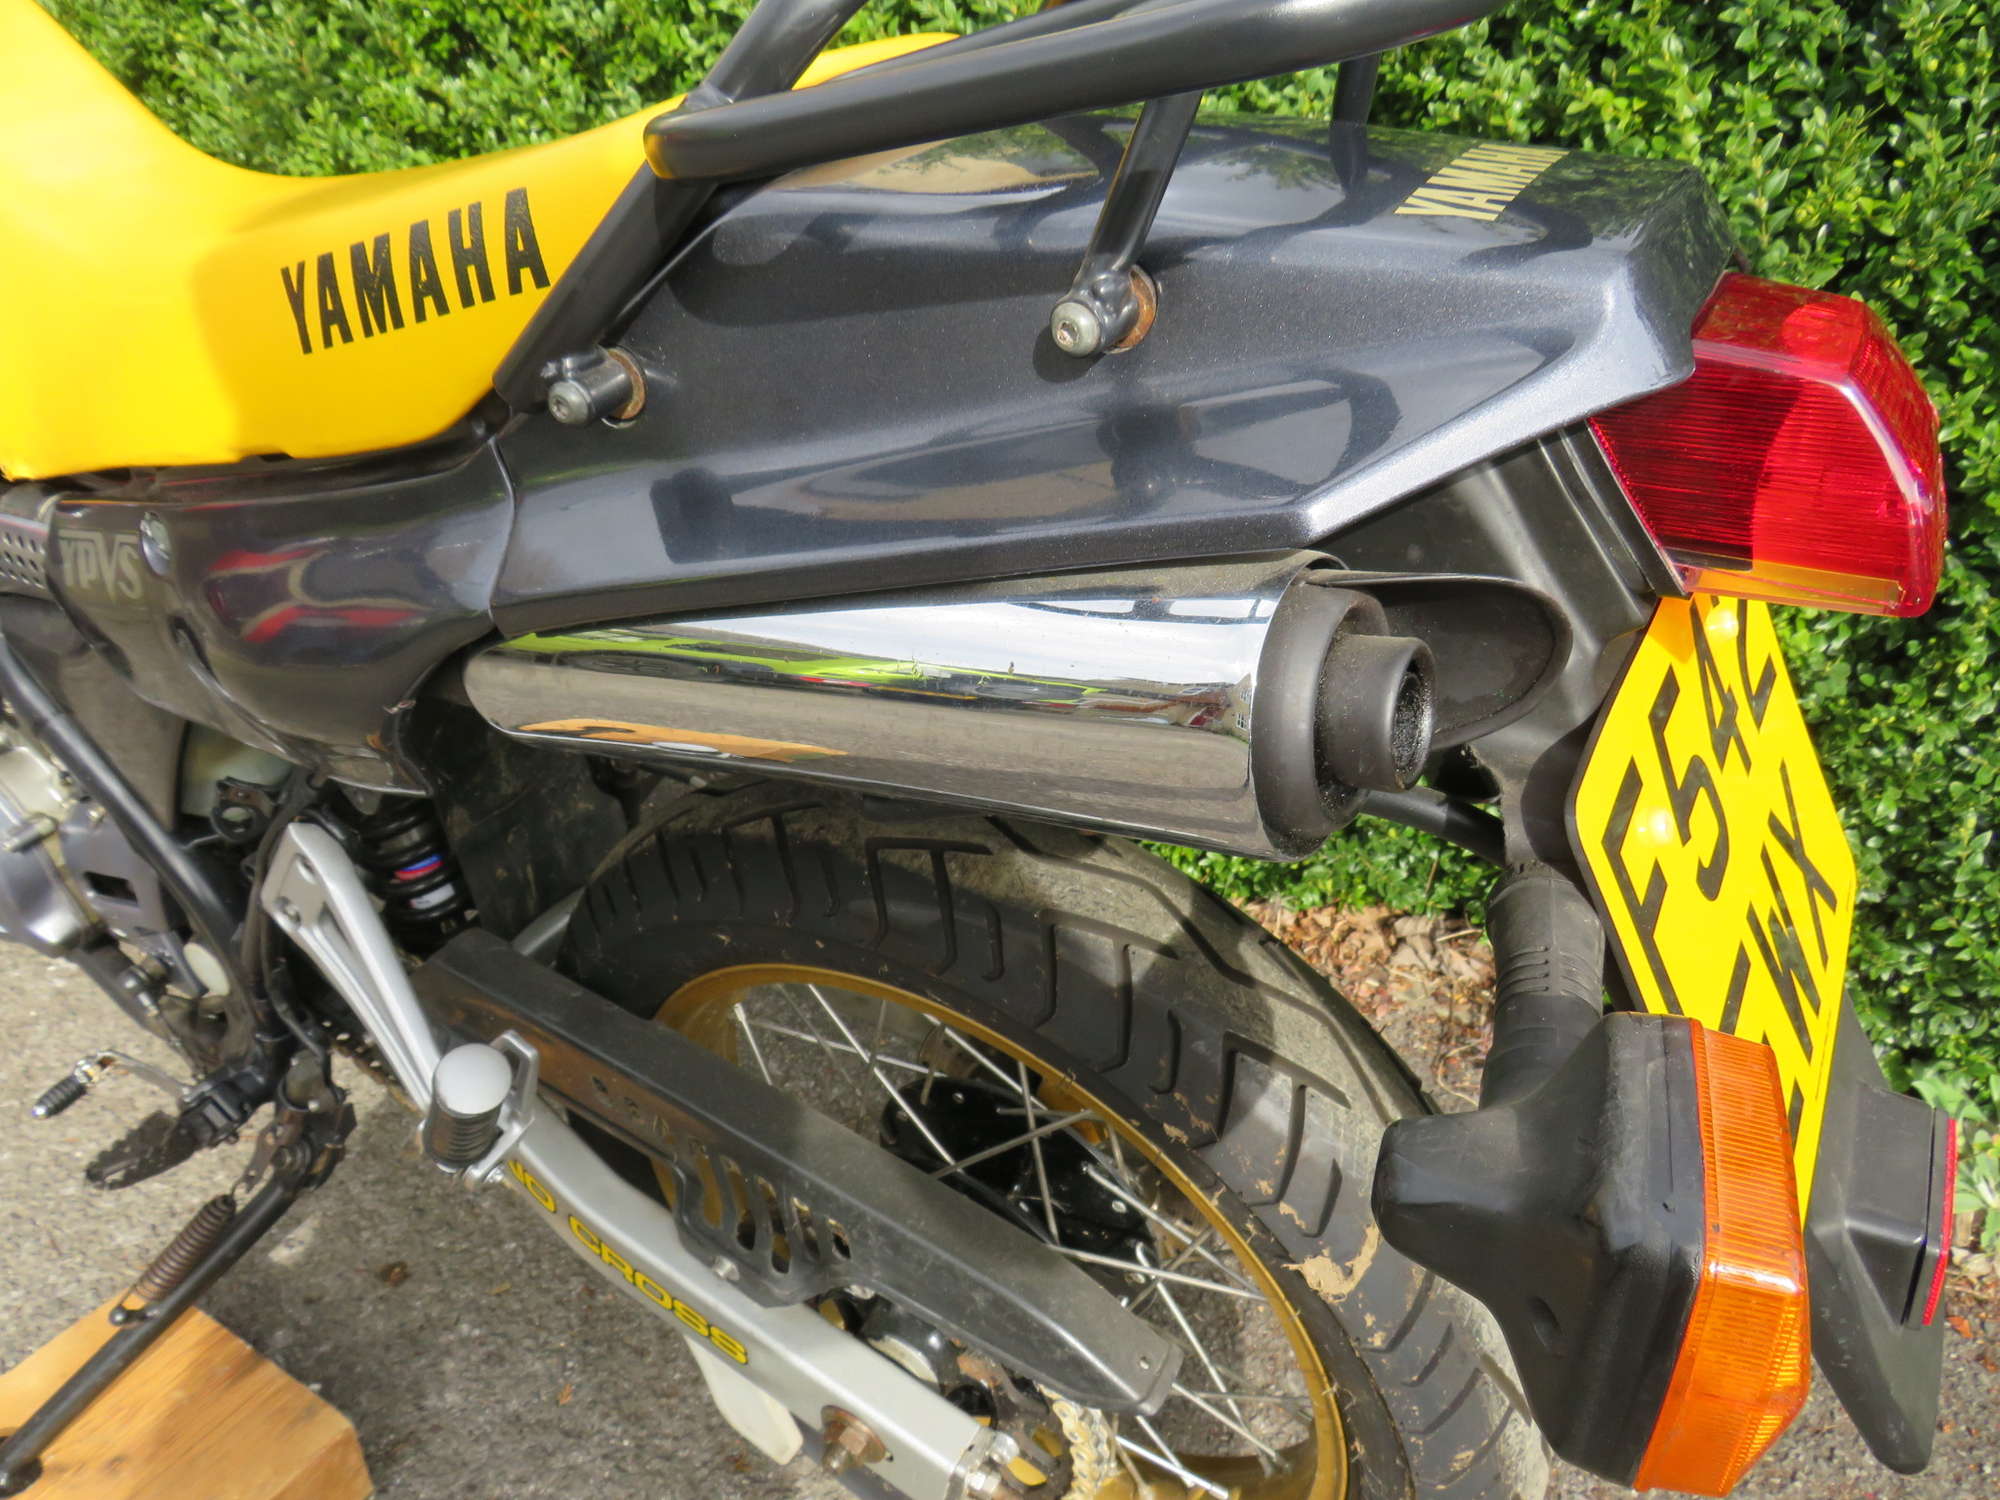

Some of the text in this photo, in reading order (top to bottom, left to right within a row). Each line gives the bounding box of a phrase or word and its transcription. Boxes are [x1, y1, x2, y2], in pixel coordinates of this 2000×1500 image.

[1394, 143, 1570, 221] YAMAHA
[280, 187, 551, 354] YAMAHA
[568, 1215, 748, 1364] CROSS
